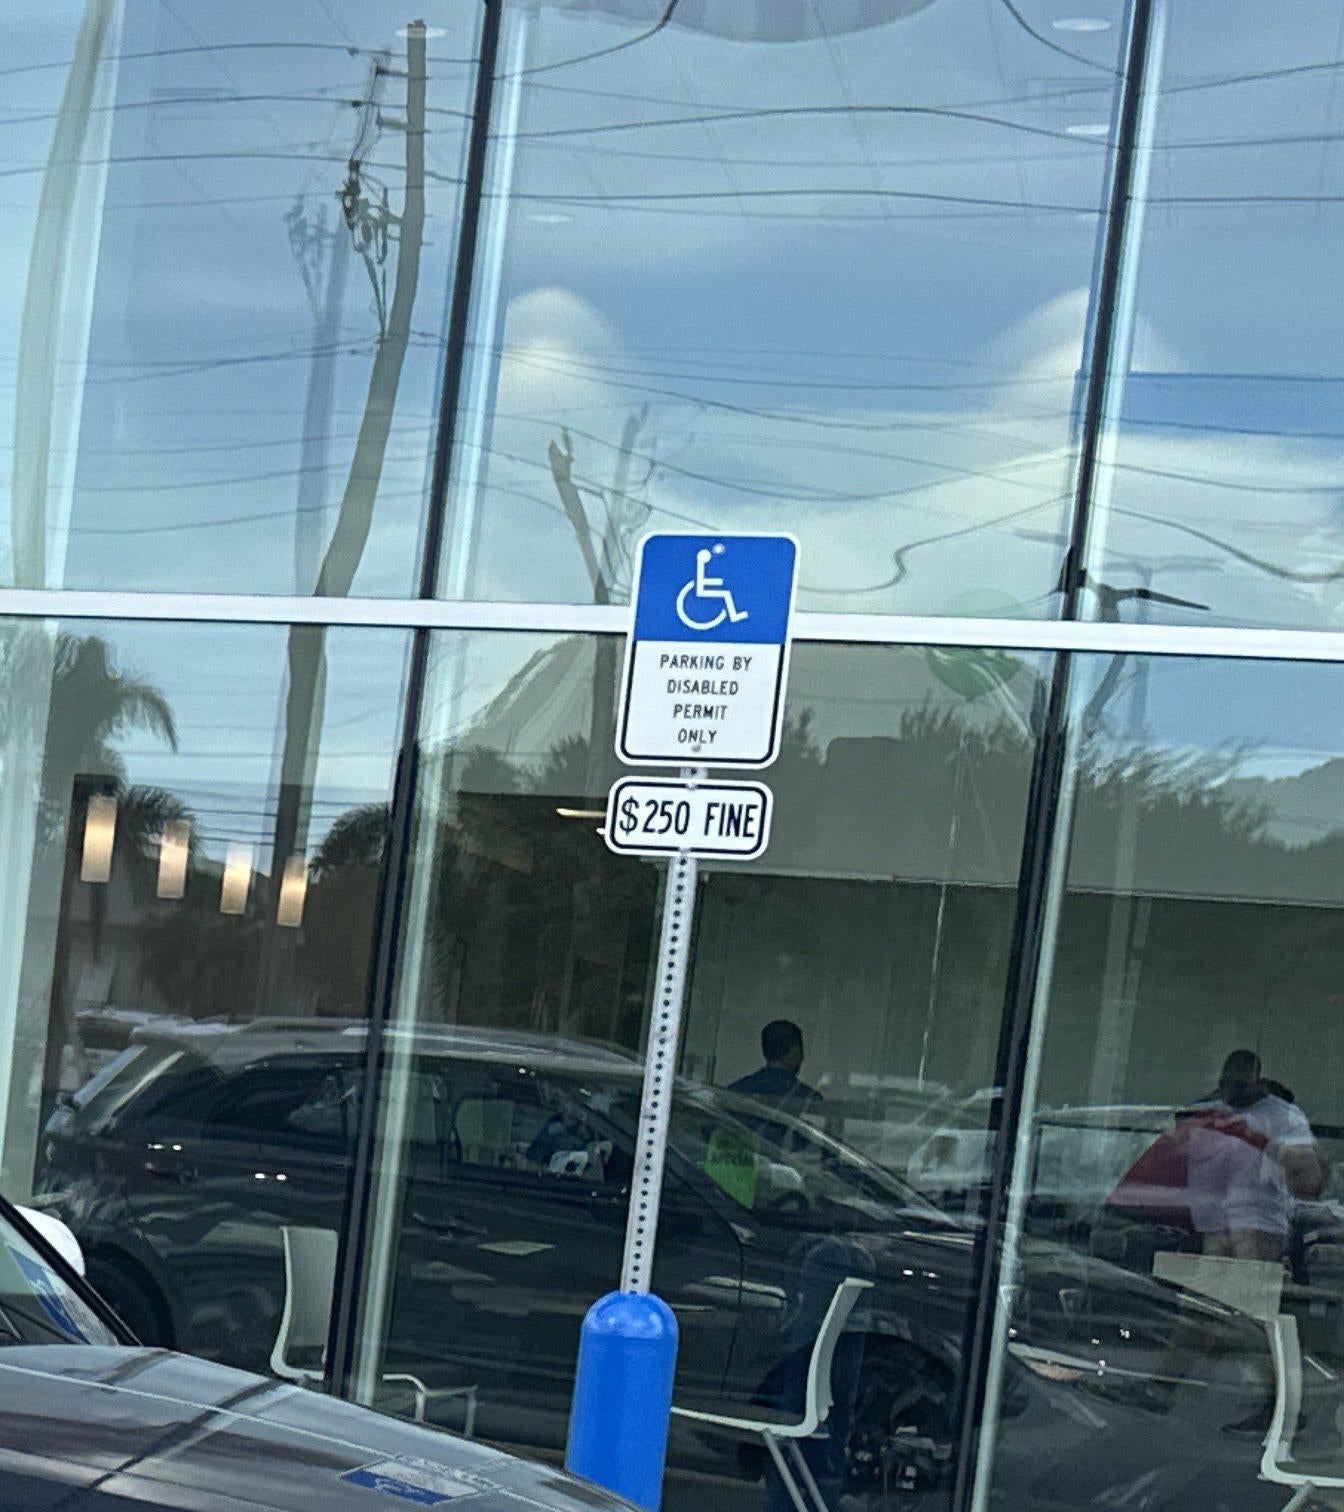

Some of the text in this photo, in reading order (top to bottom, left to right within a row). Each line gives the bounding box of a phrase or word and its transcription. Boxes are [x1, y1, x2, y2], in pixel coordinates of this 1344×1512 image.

[659, 654, 753, 671] PARKING BY
[667, 680, 739, 696] DISABLED
[673, 704, 728, 720] PERMIT
[678, 729, 717, 745] ONLY
[619, 796, 759, 838] $250 FINE
